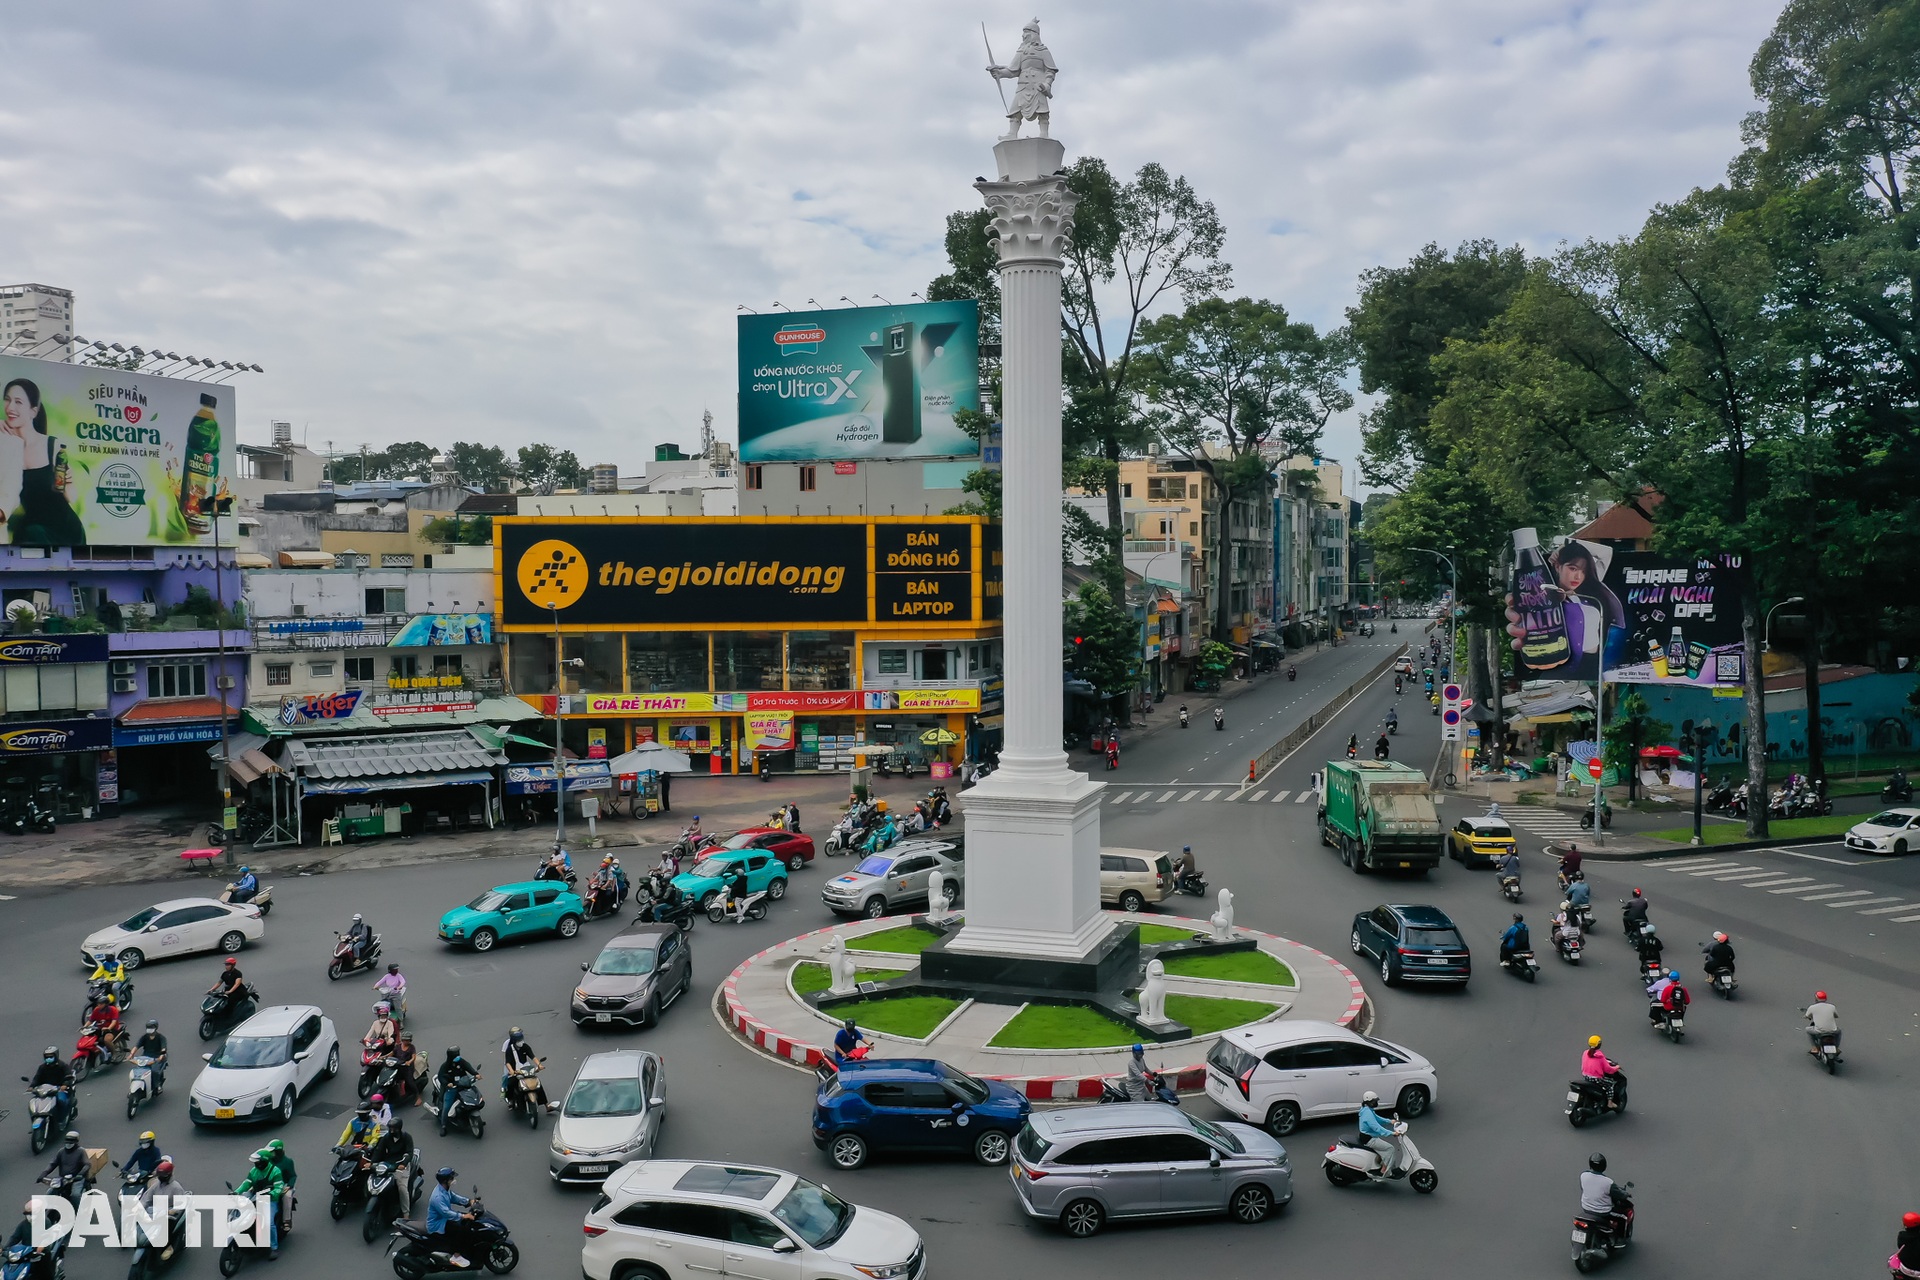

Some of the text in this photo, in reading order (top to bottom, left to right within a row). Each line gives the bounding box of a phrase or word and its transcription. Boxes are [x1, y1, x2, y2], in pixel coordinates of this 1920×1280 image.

[779, 332, 821, 342] SUNHOUSE
[754, 361, 842, 378] UỐNG NƯỚC KHỎE
[88, 384, 114, 400] SIÊU
[752, 382, 776, 394] chọn
[94, 404, 122, 420] Trà
[76, 422, 160, 445] cascara
[836, 433, 878, 442] Hydrogen
[103, 445, 119, 456] XANH
[906, 532, 939, 546] BÁN
[886, 548, 960, 568] ĐỒNG HỒ
[599, 560, 846, 594] thegioididong
[1626, 569, 1688, 584] SHAKE
[788, 586, 818, 594] .com
[906, 580, 939, 596] BÁN
[892, 602, 954, 616] LAPTOP
[1674, 604, 1714, 618] OFF
[308, 637, 336, 650] TRỌN
[339, 636, 364, 649] CUỘC
[303, 692, 358, 718] Tiger
[593, 696, 686, 710] GIÁ RẺ THẬT!
[138, 734, 155, 743] KHU
[158, 730, 175, 741] PHỐ
[178, 731, 194, 740] VĂN
[196, 730, 213, 739] HÓA
